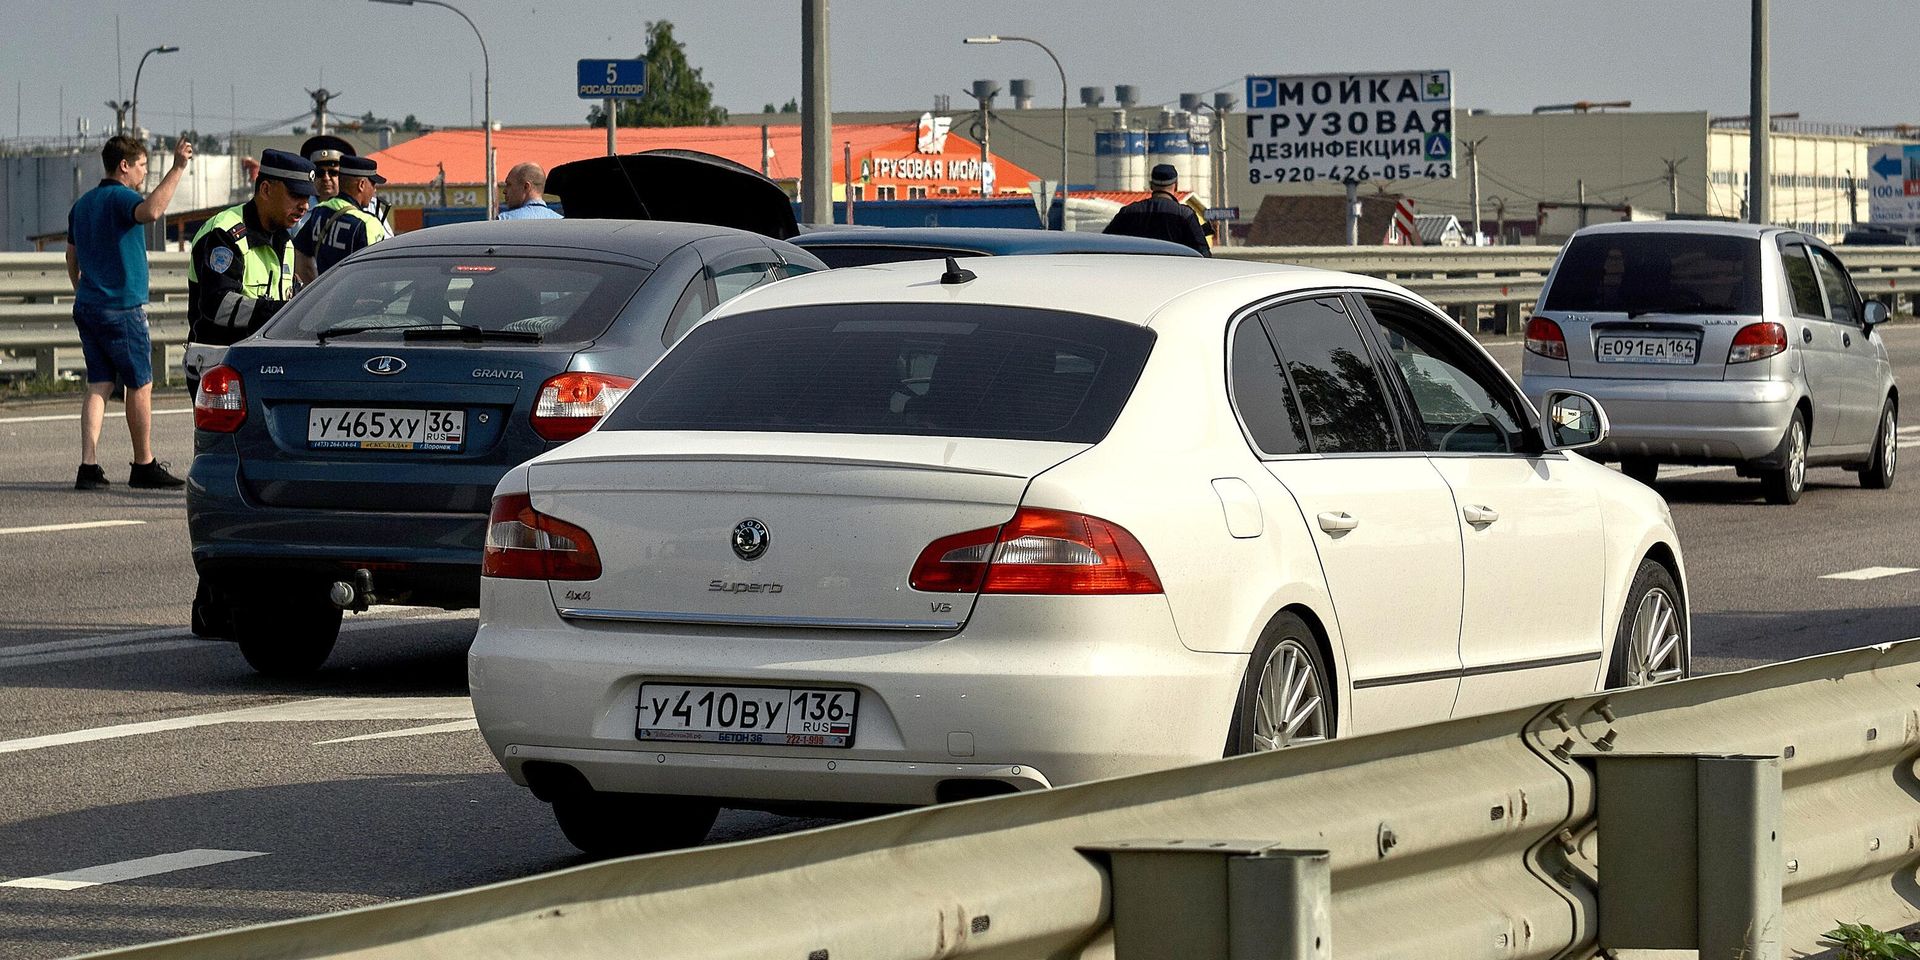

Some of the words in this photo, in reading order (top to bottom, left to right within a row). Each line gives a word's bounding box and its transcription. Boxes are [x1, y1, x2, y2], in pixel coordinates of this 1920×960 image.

[606, 63, 617, 84] 5
[580, 84, 643, 94] РОСАВТОДОР
[1278, 76, 1420, 106] МОЙКА
[1246, 109, 1450, 138] ГРУЗОВАЯ
[1249, 138, 1420, 162] ДЕЗИНФЕКЦИЯ
[874, 158, 942, 180] ГРУЗОВАЯ
[1249, 163, 1450, 184] 8-920-426-05-43
[1873, 184, 1893, 198] 100
[378, 191, 441, 206] ОНТАЖ
[453, 191, 477, 205] 24
[1668, 340, 1693, 352] 164
[260, 365, 284, 374] LADA
[471, 368, 524, 379] GRANTA
[428, 412, 454, 432] 36
[426, 433, 446, 441] RUS
[708, 580, 784, 595] Superb
[565, 590, 591, 601] 4x4
[931, 601, 952, 612] V6
[793, 692, 844, 721] 136
[803, 722, 829, 733] RUS
[718, 732, 749, 742] БЕТОН
[750, 734, 763, 743] 36
[786, 735, 824, 745] 222-1-999
